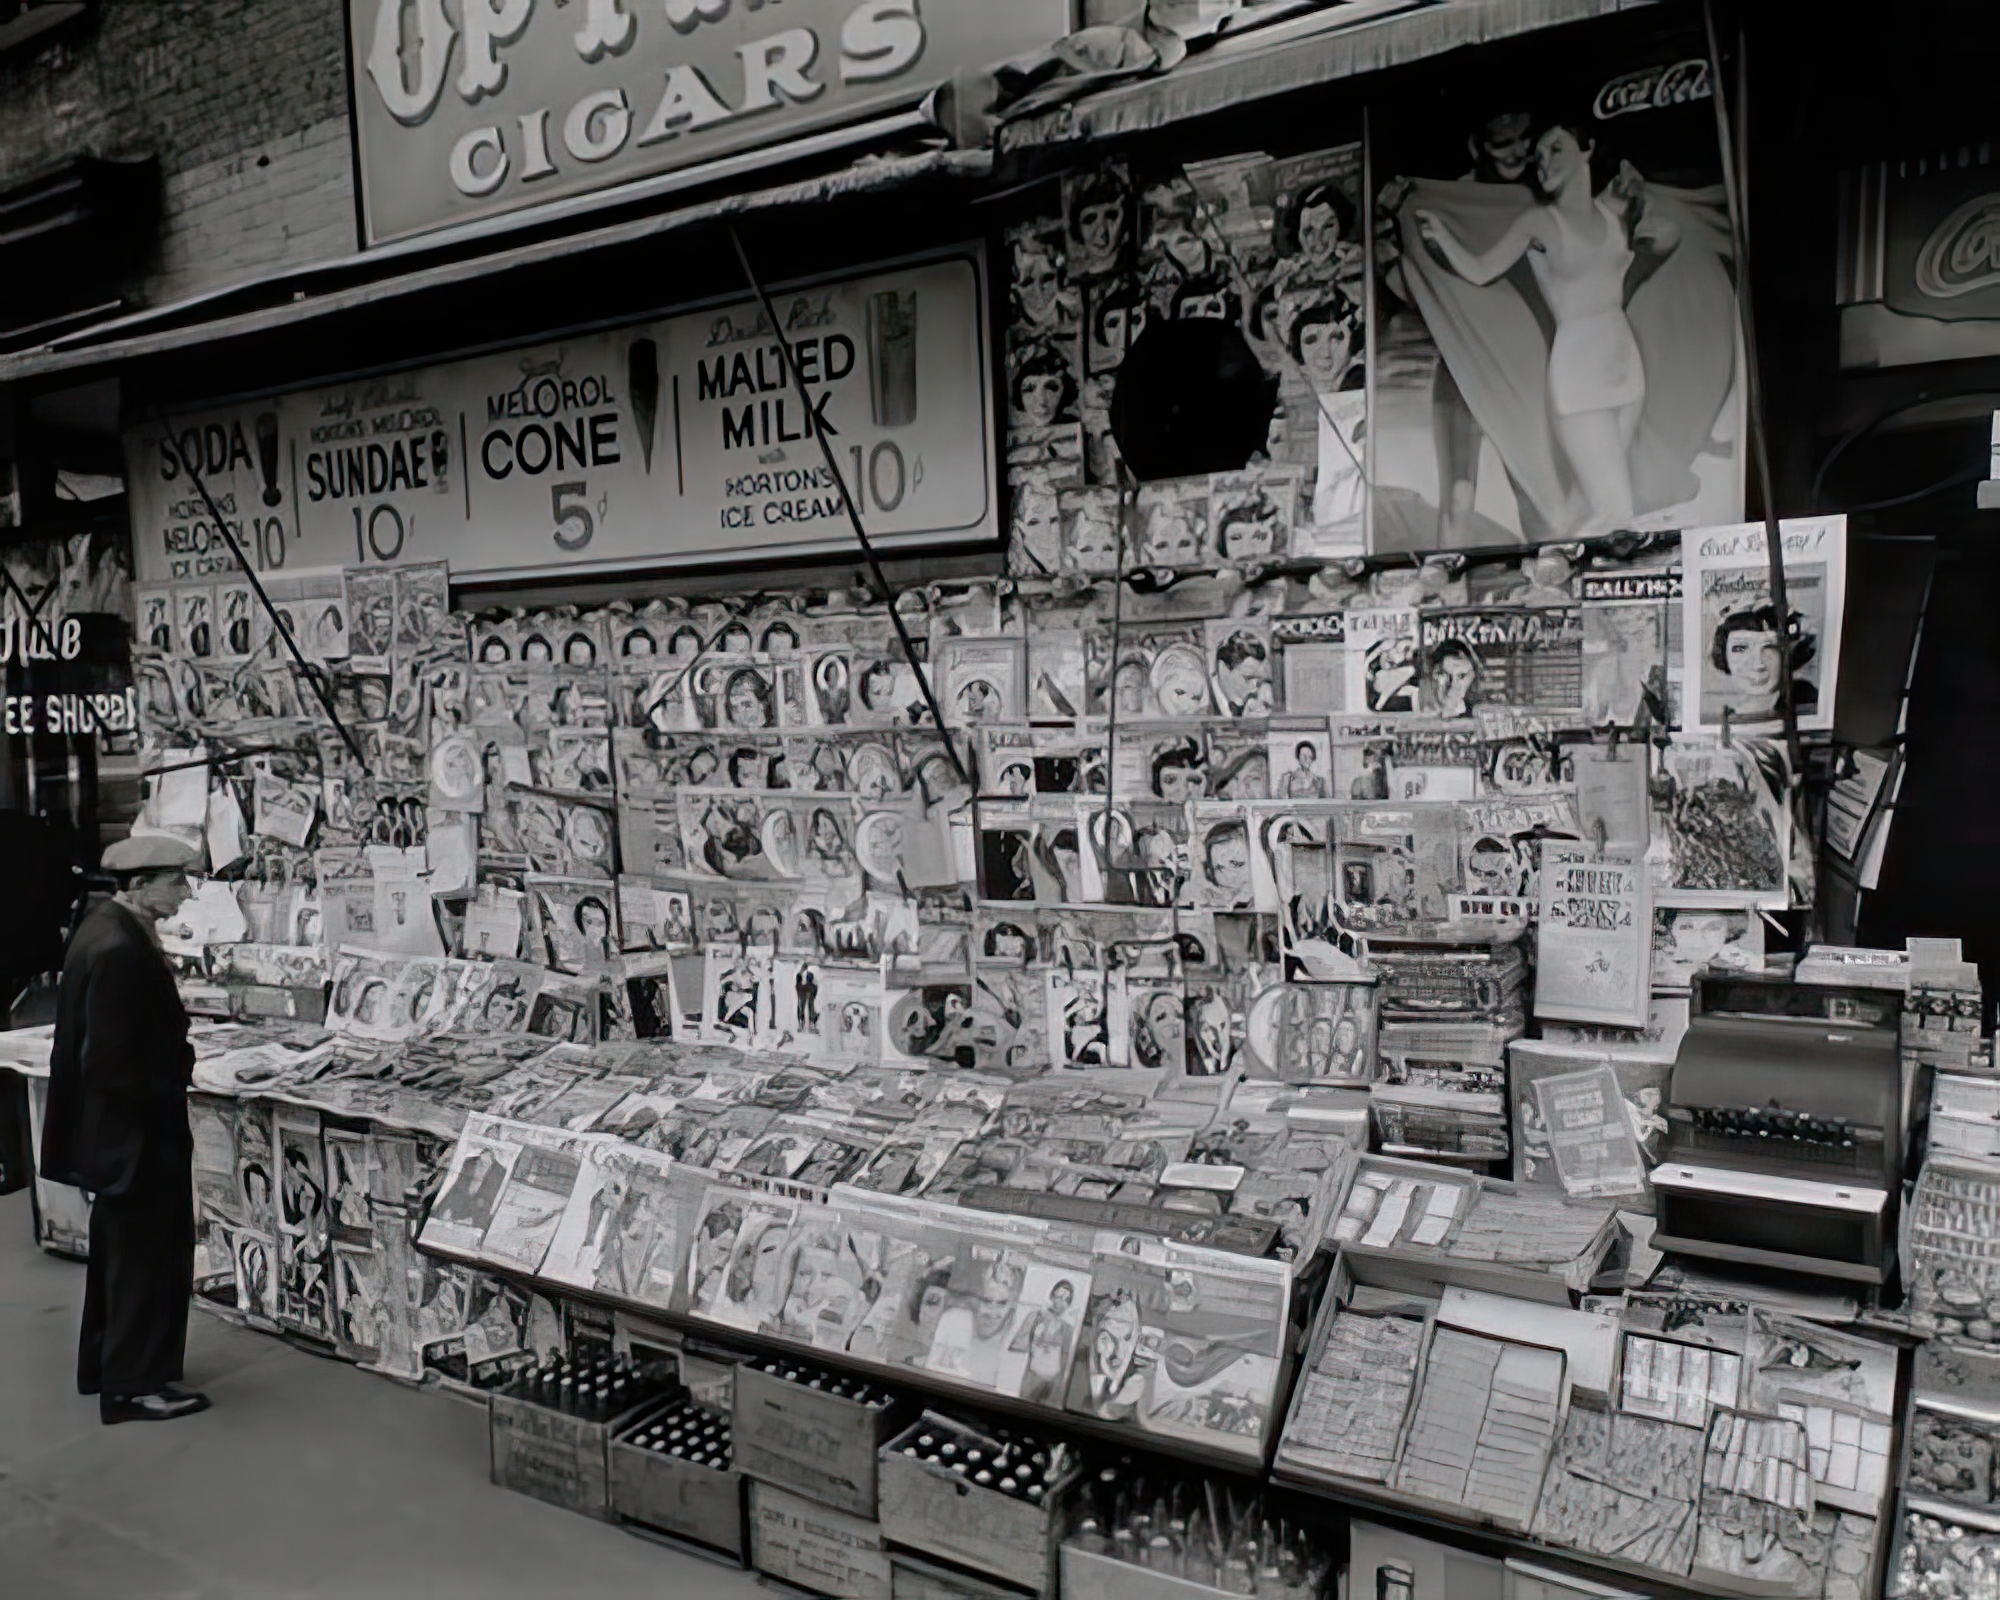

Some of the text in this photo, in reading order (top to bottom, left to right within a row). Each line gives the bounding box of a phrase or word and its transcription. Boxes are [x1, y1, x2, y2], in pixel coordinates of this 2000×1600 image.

[449, 0, 926, 196] CIGARS
[487, 375, 615, 421] MELOROL
[697, 334, 855, 401] MALTED
[159, 416, 255, 481] SODA
[481, 412, 621, 481] CONE
[721, 391, 839, 450] MILK
[306, 436, 428, 502] SUNDAE
